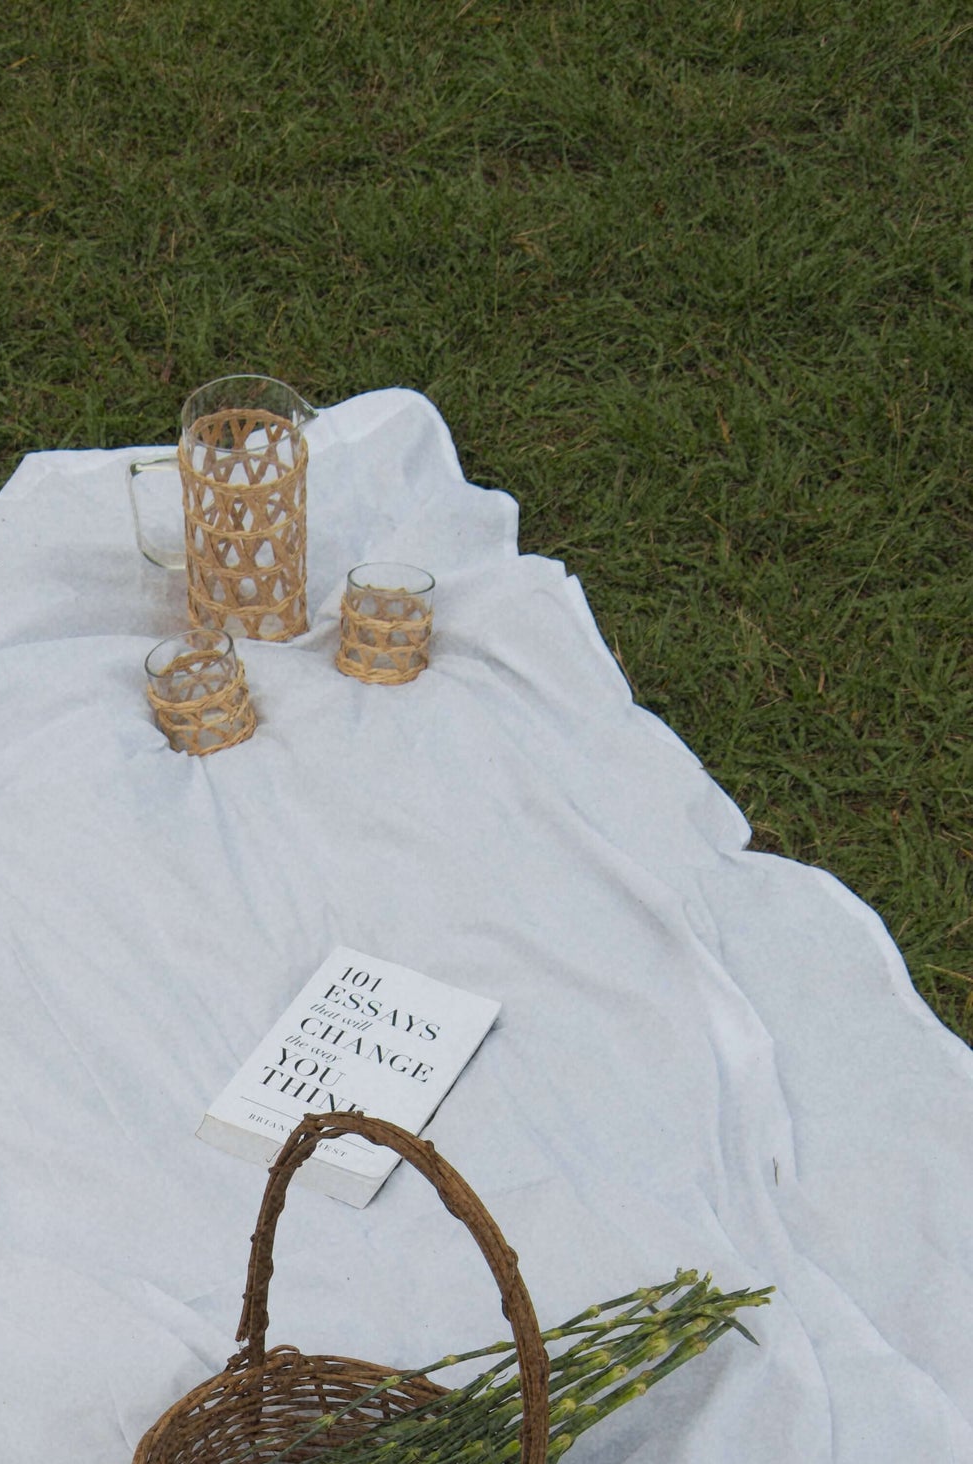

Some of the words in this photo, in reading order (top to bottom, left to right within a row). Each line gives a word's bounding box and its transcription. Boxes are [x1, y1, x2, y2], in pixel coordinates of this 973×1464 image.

[338, 967, 383, 992] 101
[310, 1003, 341, 1019] that
[342, 1018, 373, 1031] will
[320, 983, 441, 1041] ESSAYS
[285, 1035, 308, 1047] the
[311, 1046, 342, 1063] way
[300, 1017, 434, 1082] CHANGE
[275, 1047, 346, 1086] YOU
[318, 1142, 348, 1157] IEST
